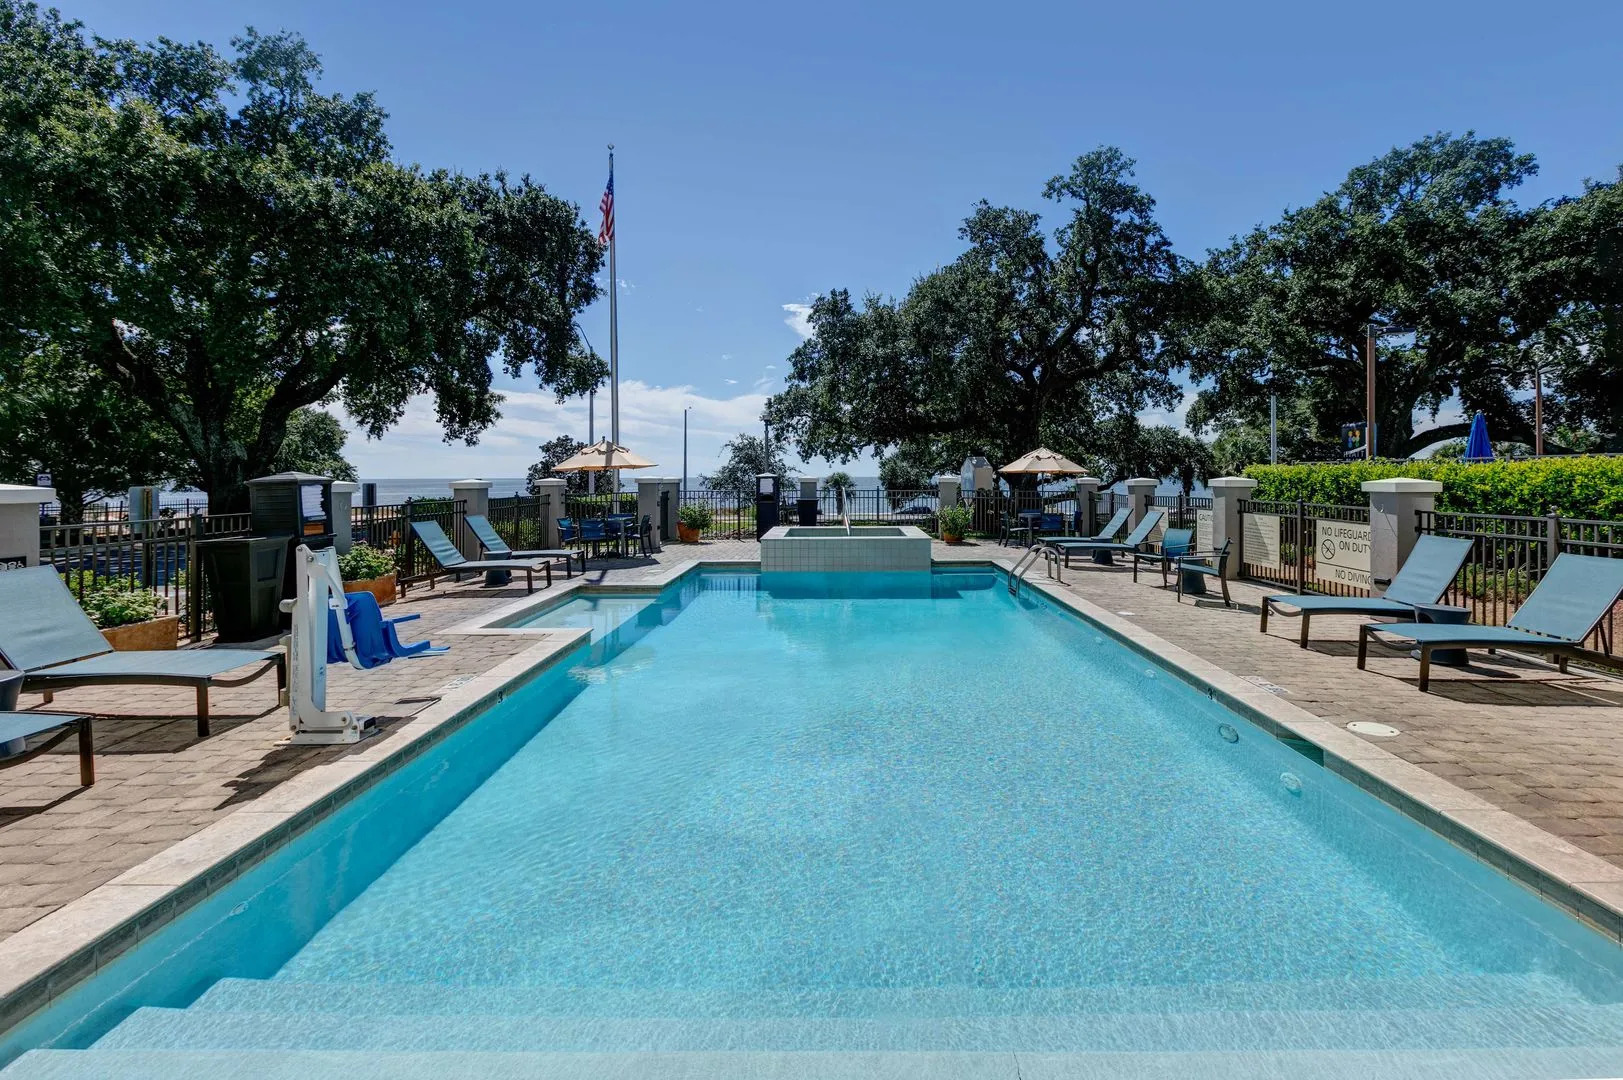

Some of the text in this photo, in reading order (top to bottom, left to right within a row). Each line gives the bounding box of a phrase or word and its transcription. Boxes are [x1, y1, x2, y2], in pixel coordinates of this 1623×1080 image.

[1322, 526, 1332, 536] NO
[1339, 540, 1350, 551] ON
[1335, 569, 1346, 580] NO
